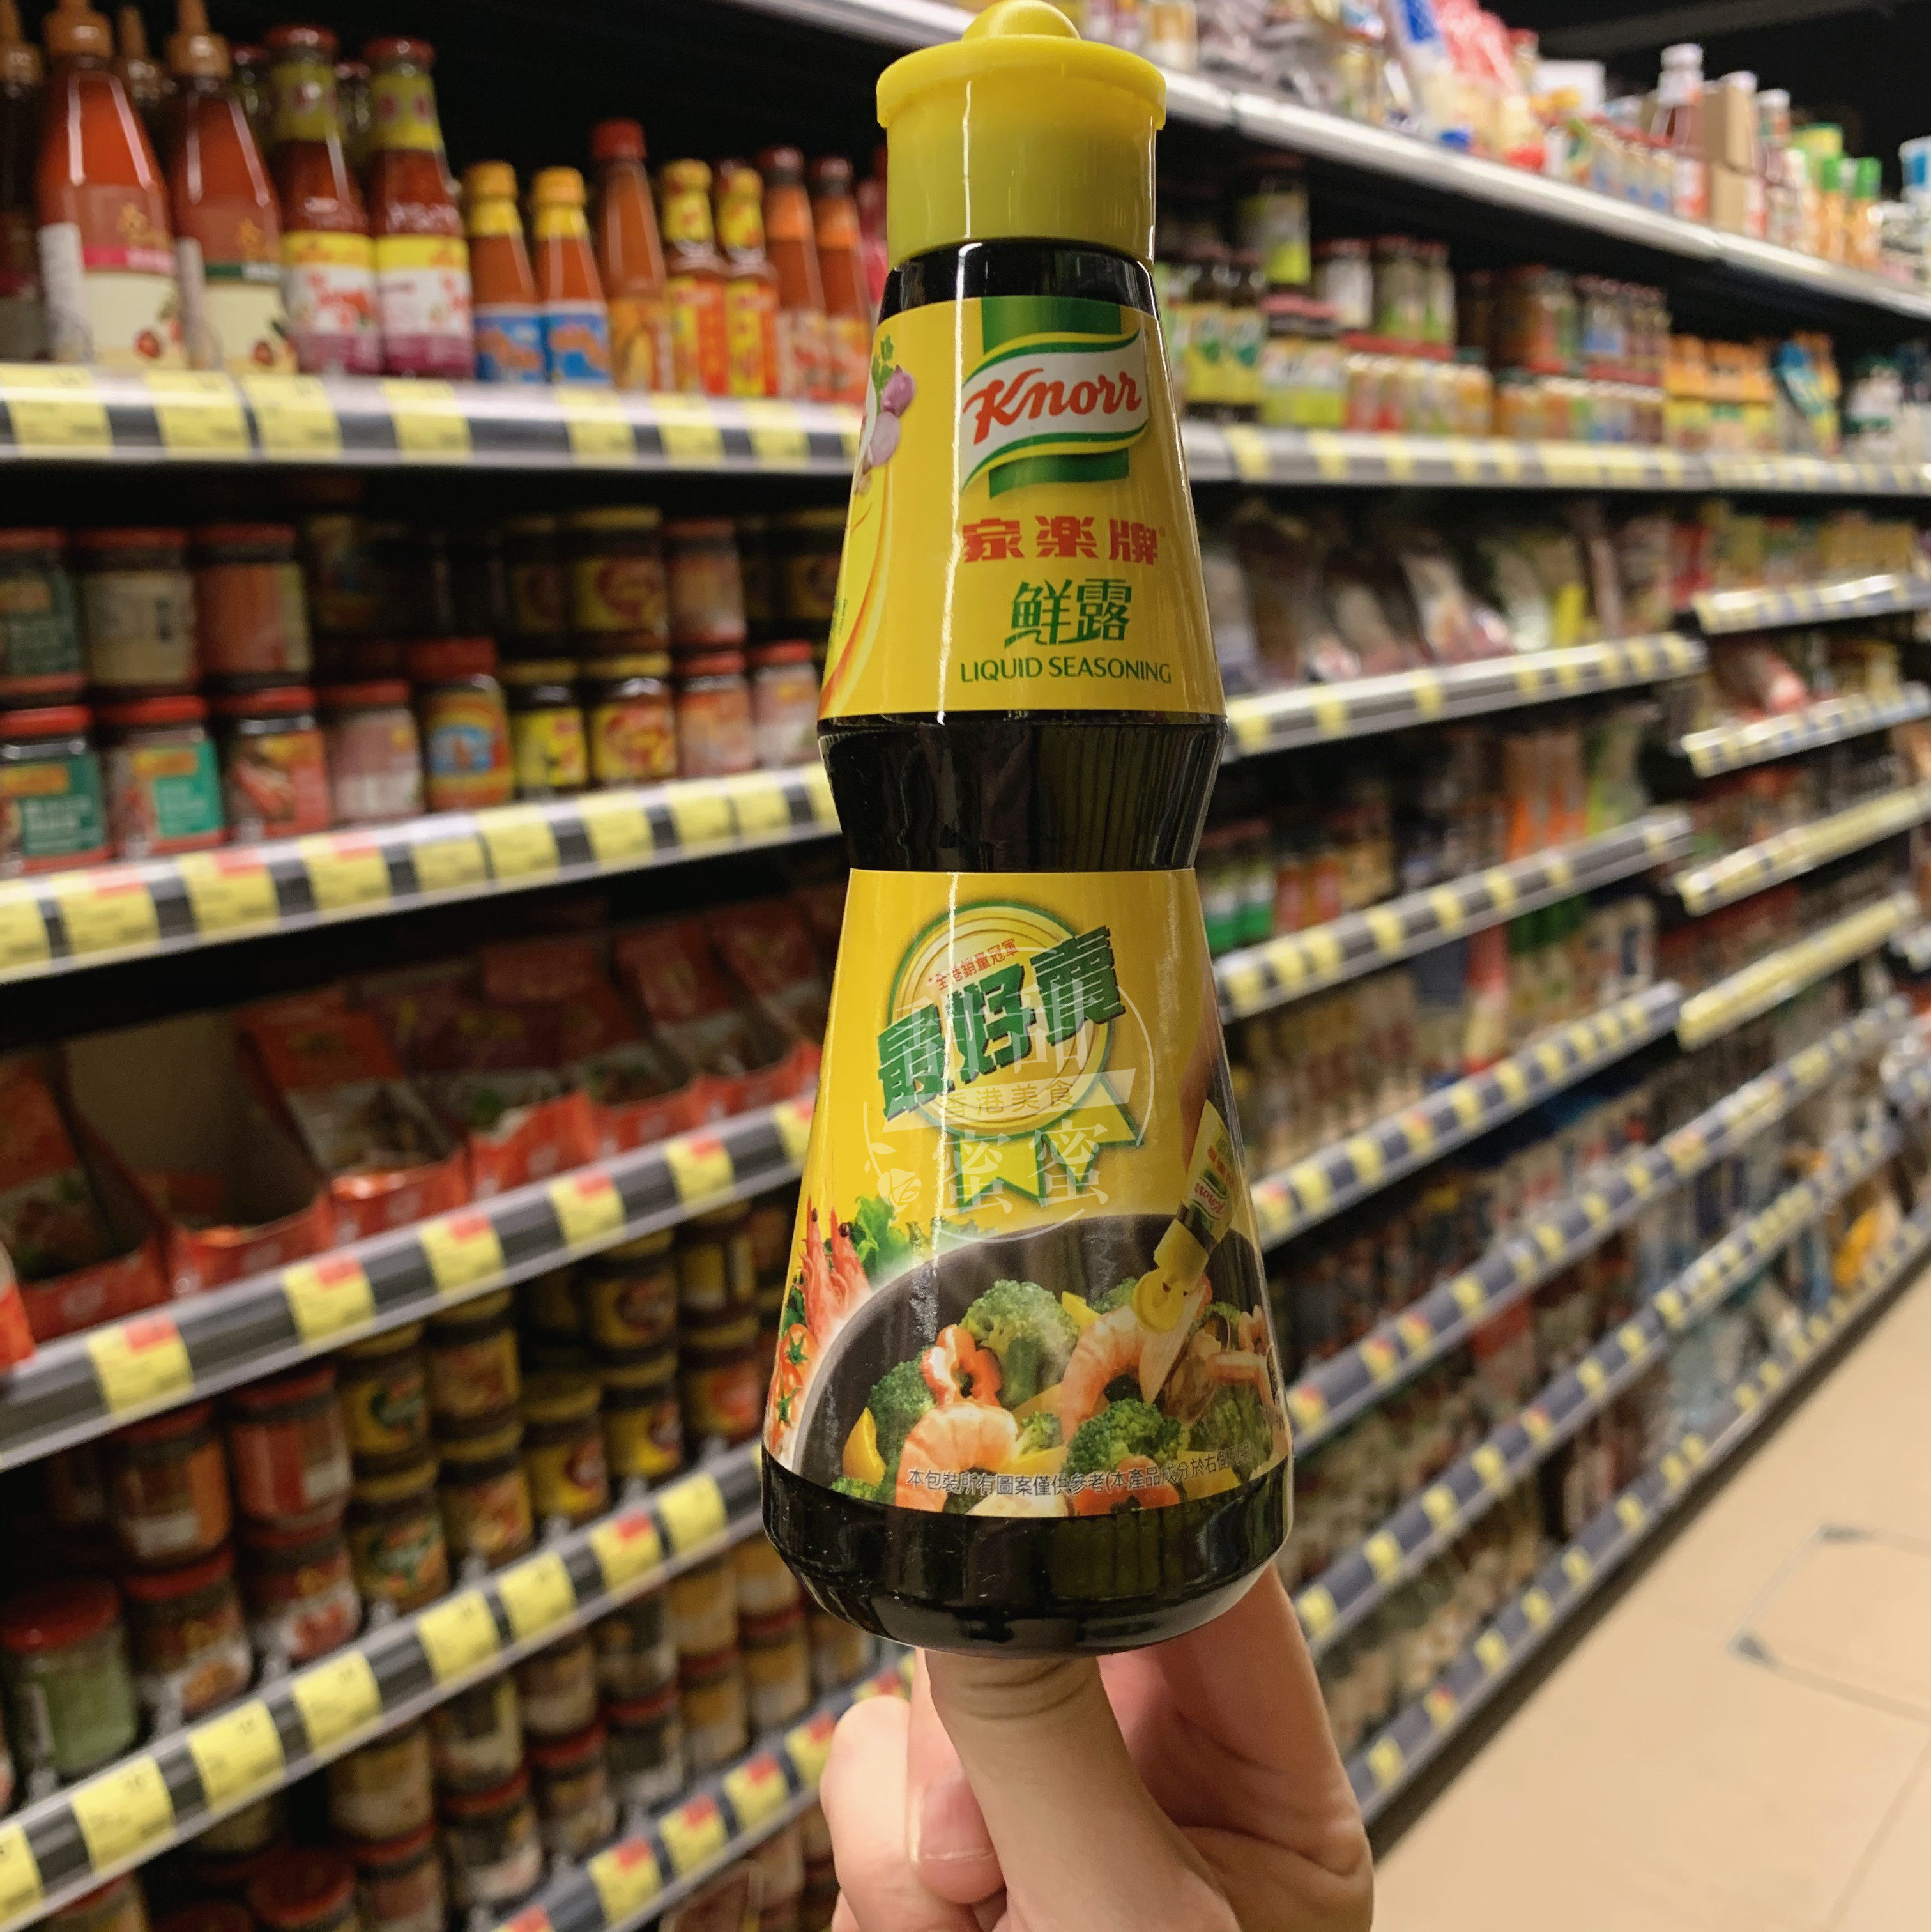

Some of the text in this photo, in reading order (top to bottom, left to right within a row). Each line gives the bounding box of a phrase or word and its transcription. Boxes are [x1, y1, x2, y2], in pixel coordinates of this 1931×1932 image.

[963, 368, 1142, 445] Knorr
[1004, 578, 1132, 649] 鮮露
[960, 656, 1172, 685] LIQUID SEASONING
[878, 926, 1126, 1122] 最好賣
